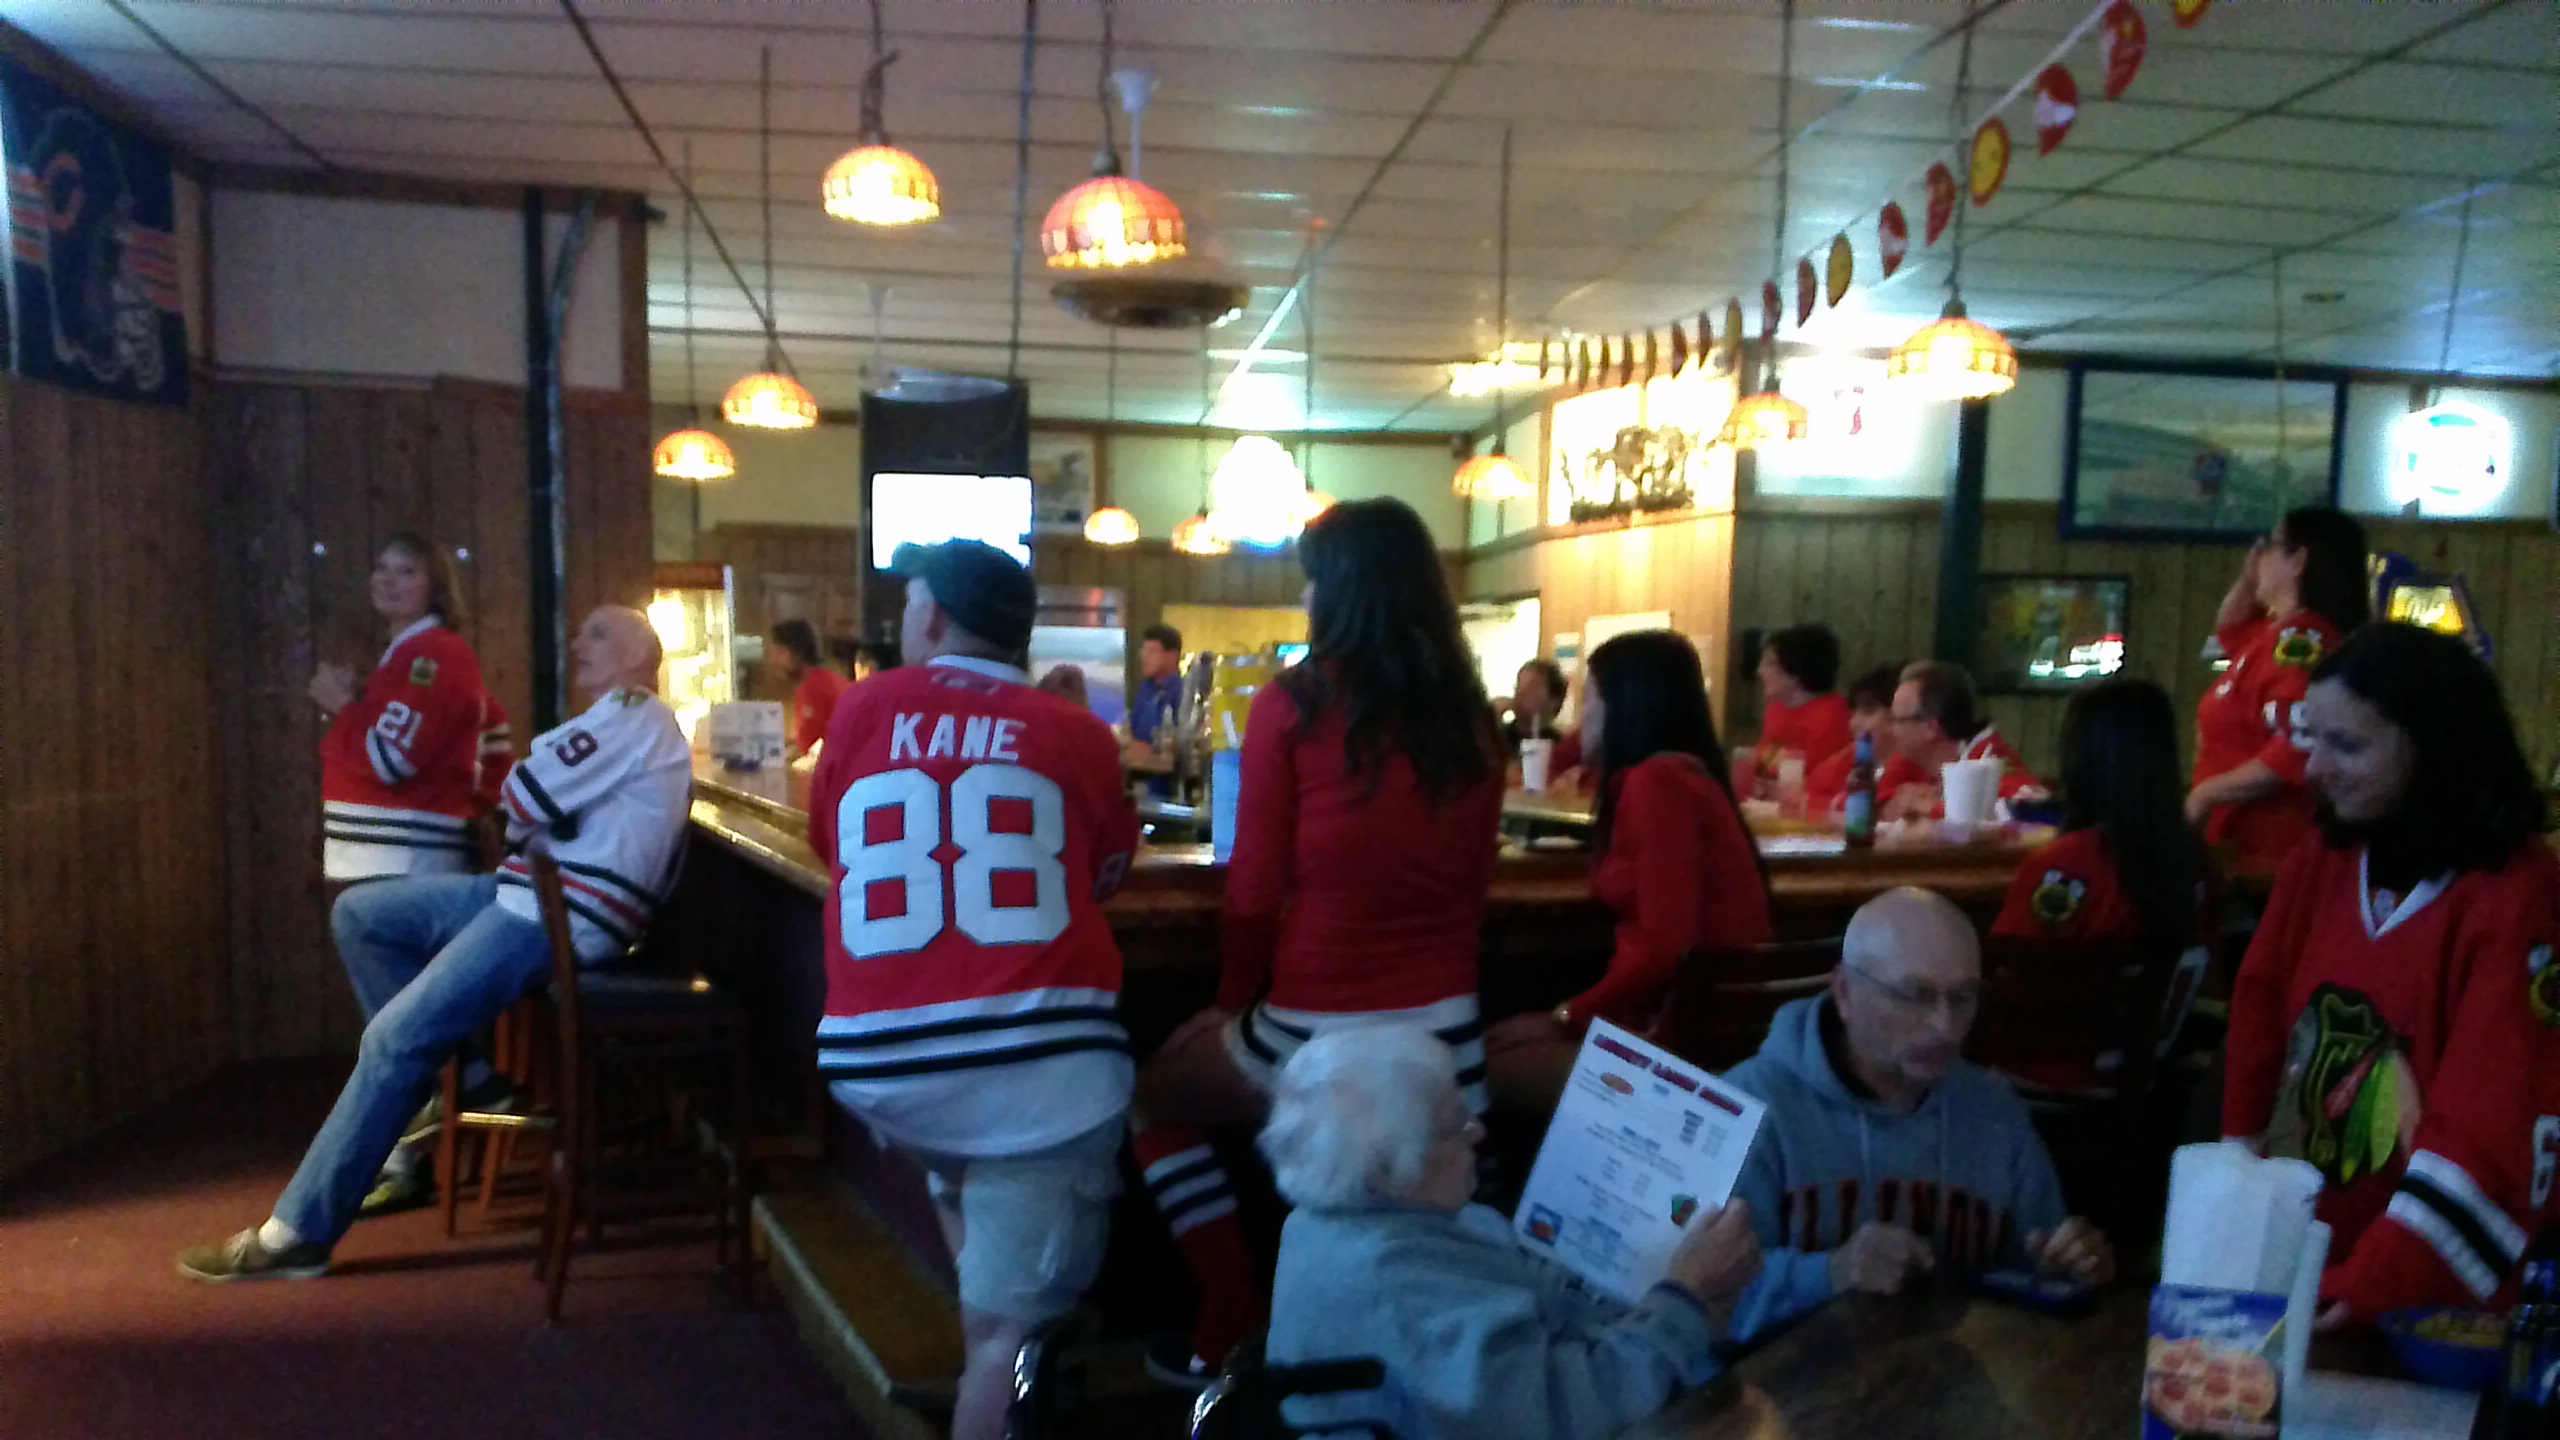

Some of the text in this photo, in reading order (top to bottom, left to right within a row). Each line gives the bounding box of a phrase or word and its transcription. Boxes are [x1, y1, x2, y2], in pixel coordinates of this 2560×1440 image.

[375, 700, 423, 750] 21
[890, 712, 1027, 762] KANE
[837, 762, 1072, 961] 88
